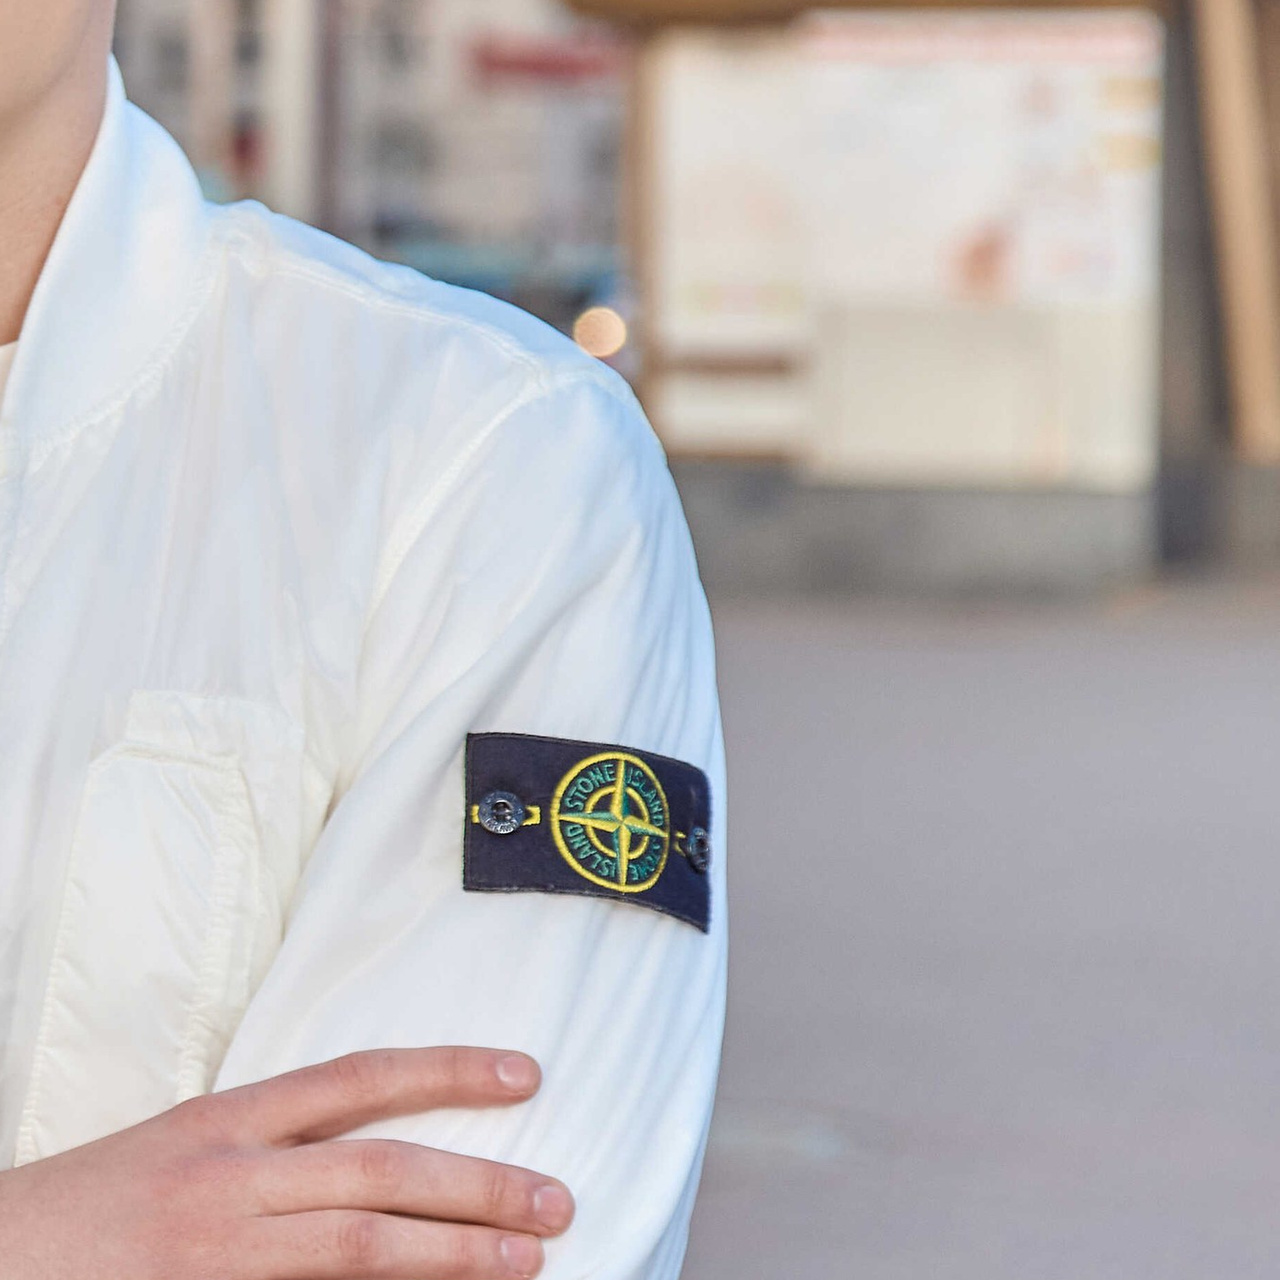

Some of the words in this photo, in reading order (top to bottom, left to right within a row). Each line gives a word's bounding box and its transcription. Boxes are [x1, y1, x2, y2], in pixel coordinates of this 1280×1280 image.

[565, 764, 616, 811] STONE
[626, 768, 663, 826] ISLAND
[565, 824, 616, 877] ISLAND
